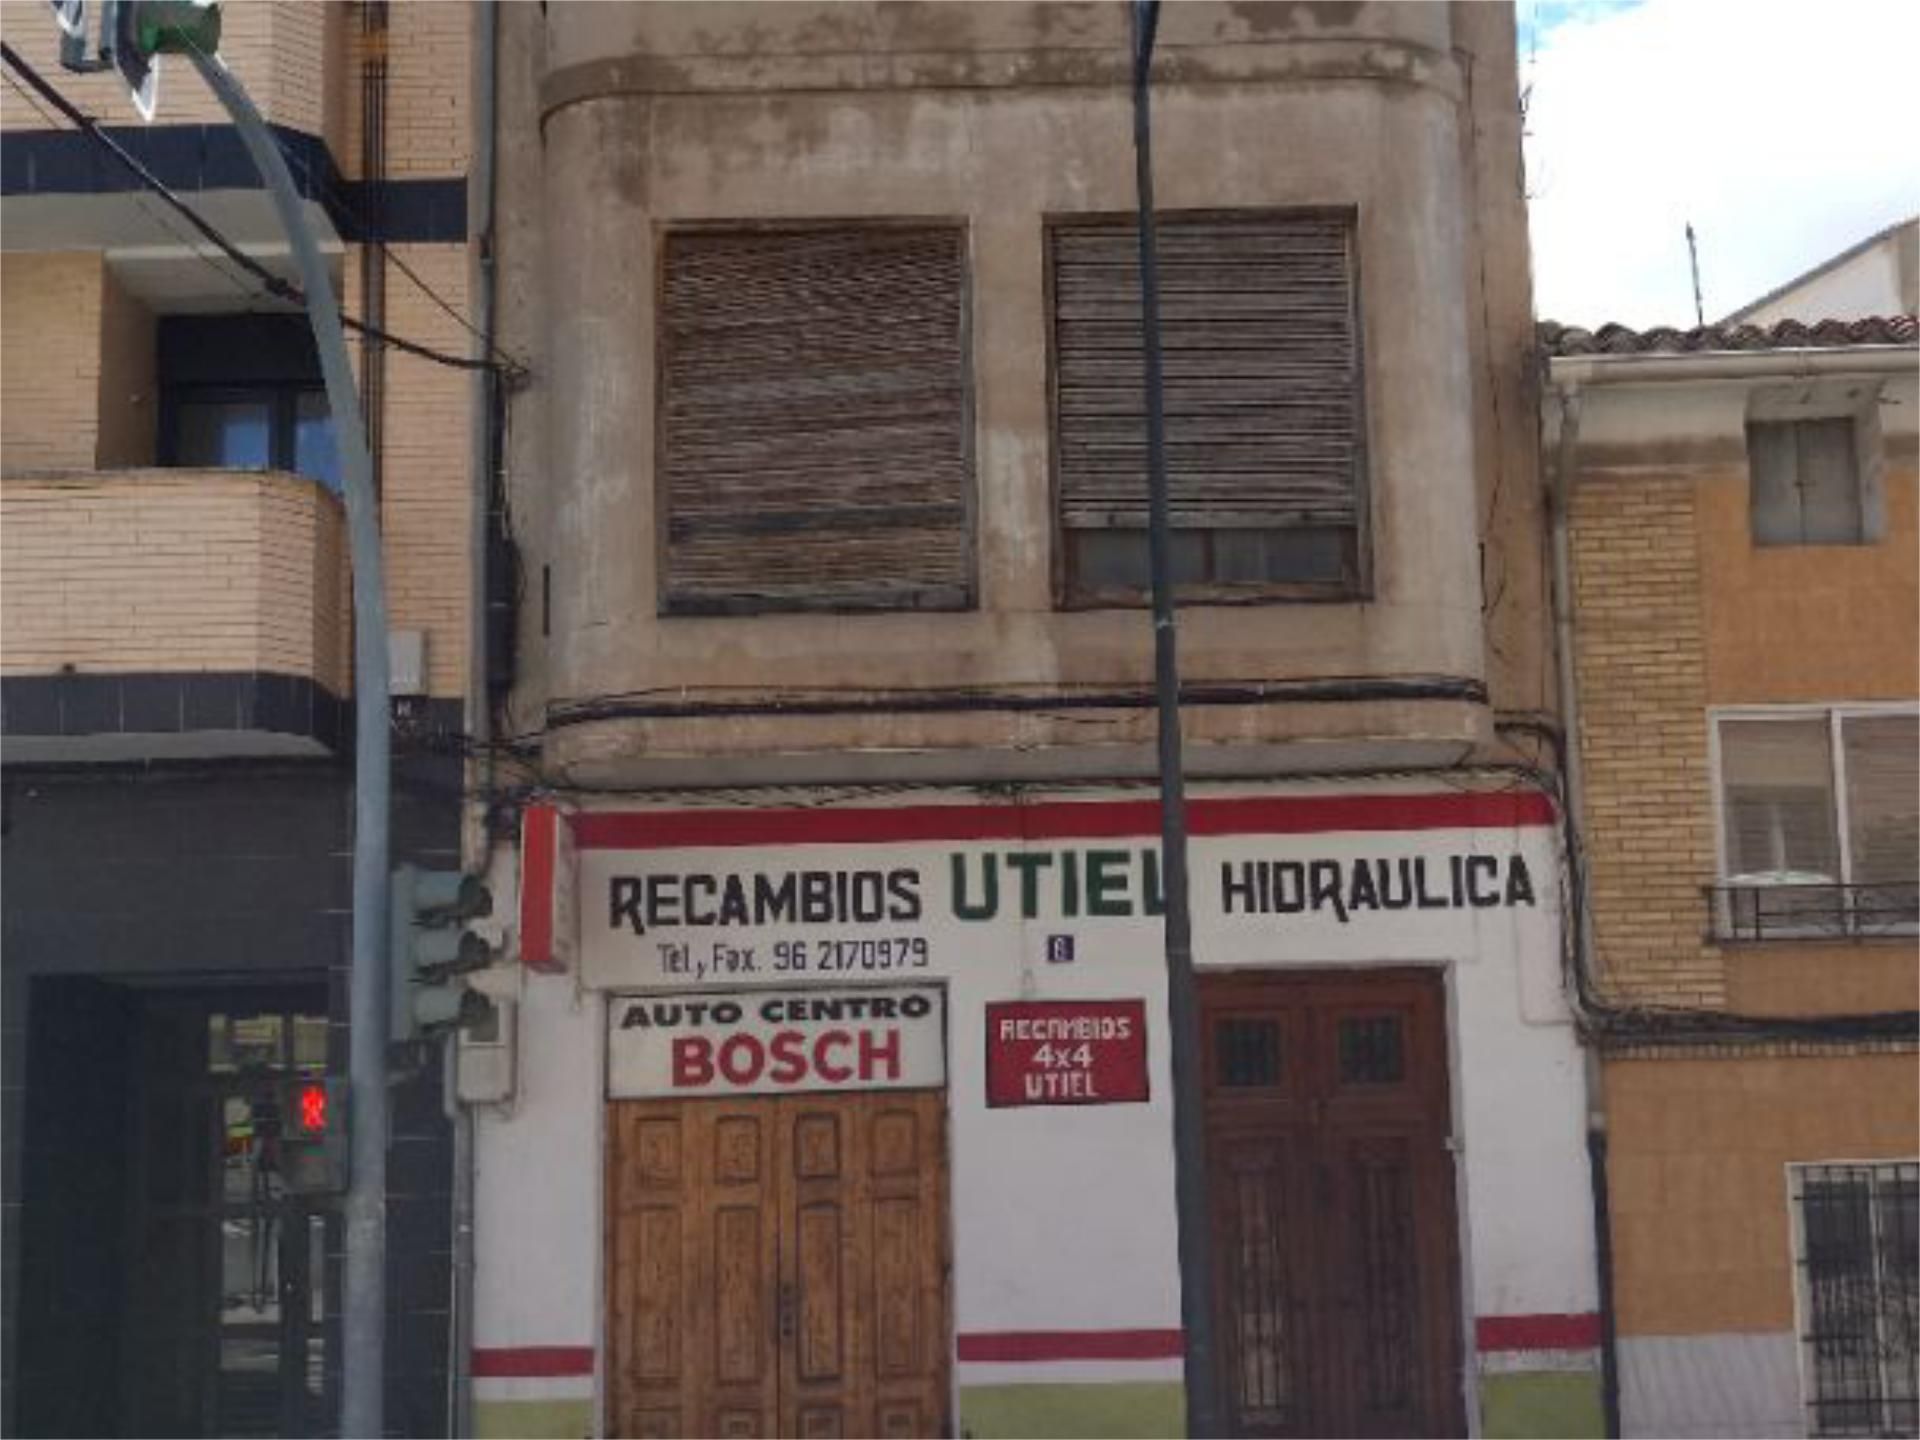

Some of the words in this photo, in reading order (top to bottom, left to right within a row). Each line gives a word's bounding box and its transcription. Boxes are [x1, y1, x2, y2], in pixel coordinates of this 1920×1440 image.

[610, 869, 921, 935] RECAMBIOS
[951, 849, 1166, 921] UTIEL
[1221, 853, 1536, 923] HIDRAULICA
[773, 941, 806, 971] 96
[817, 937, 928, 971] 2170979
[621, 1003, 743, 1029] AUTO
[760, 994, 931, 1024] CENTRO
[1000, 1016, 1132, 1041] RECAMBIOS
[672, 1028, 901, 1087] BOSCH
[1033, 1042, 1094, 1069] 4x4
[1025, 1072, 1099, 1100] UTIEL
